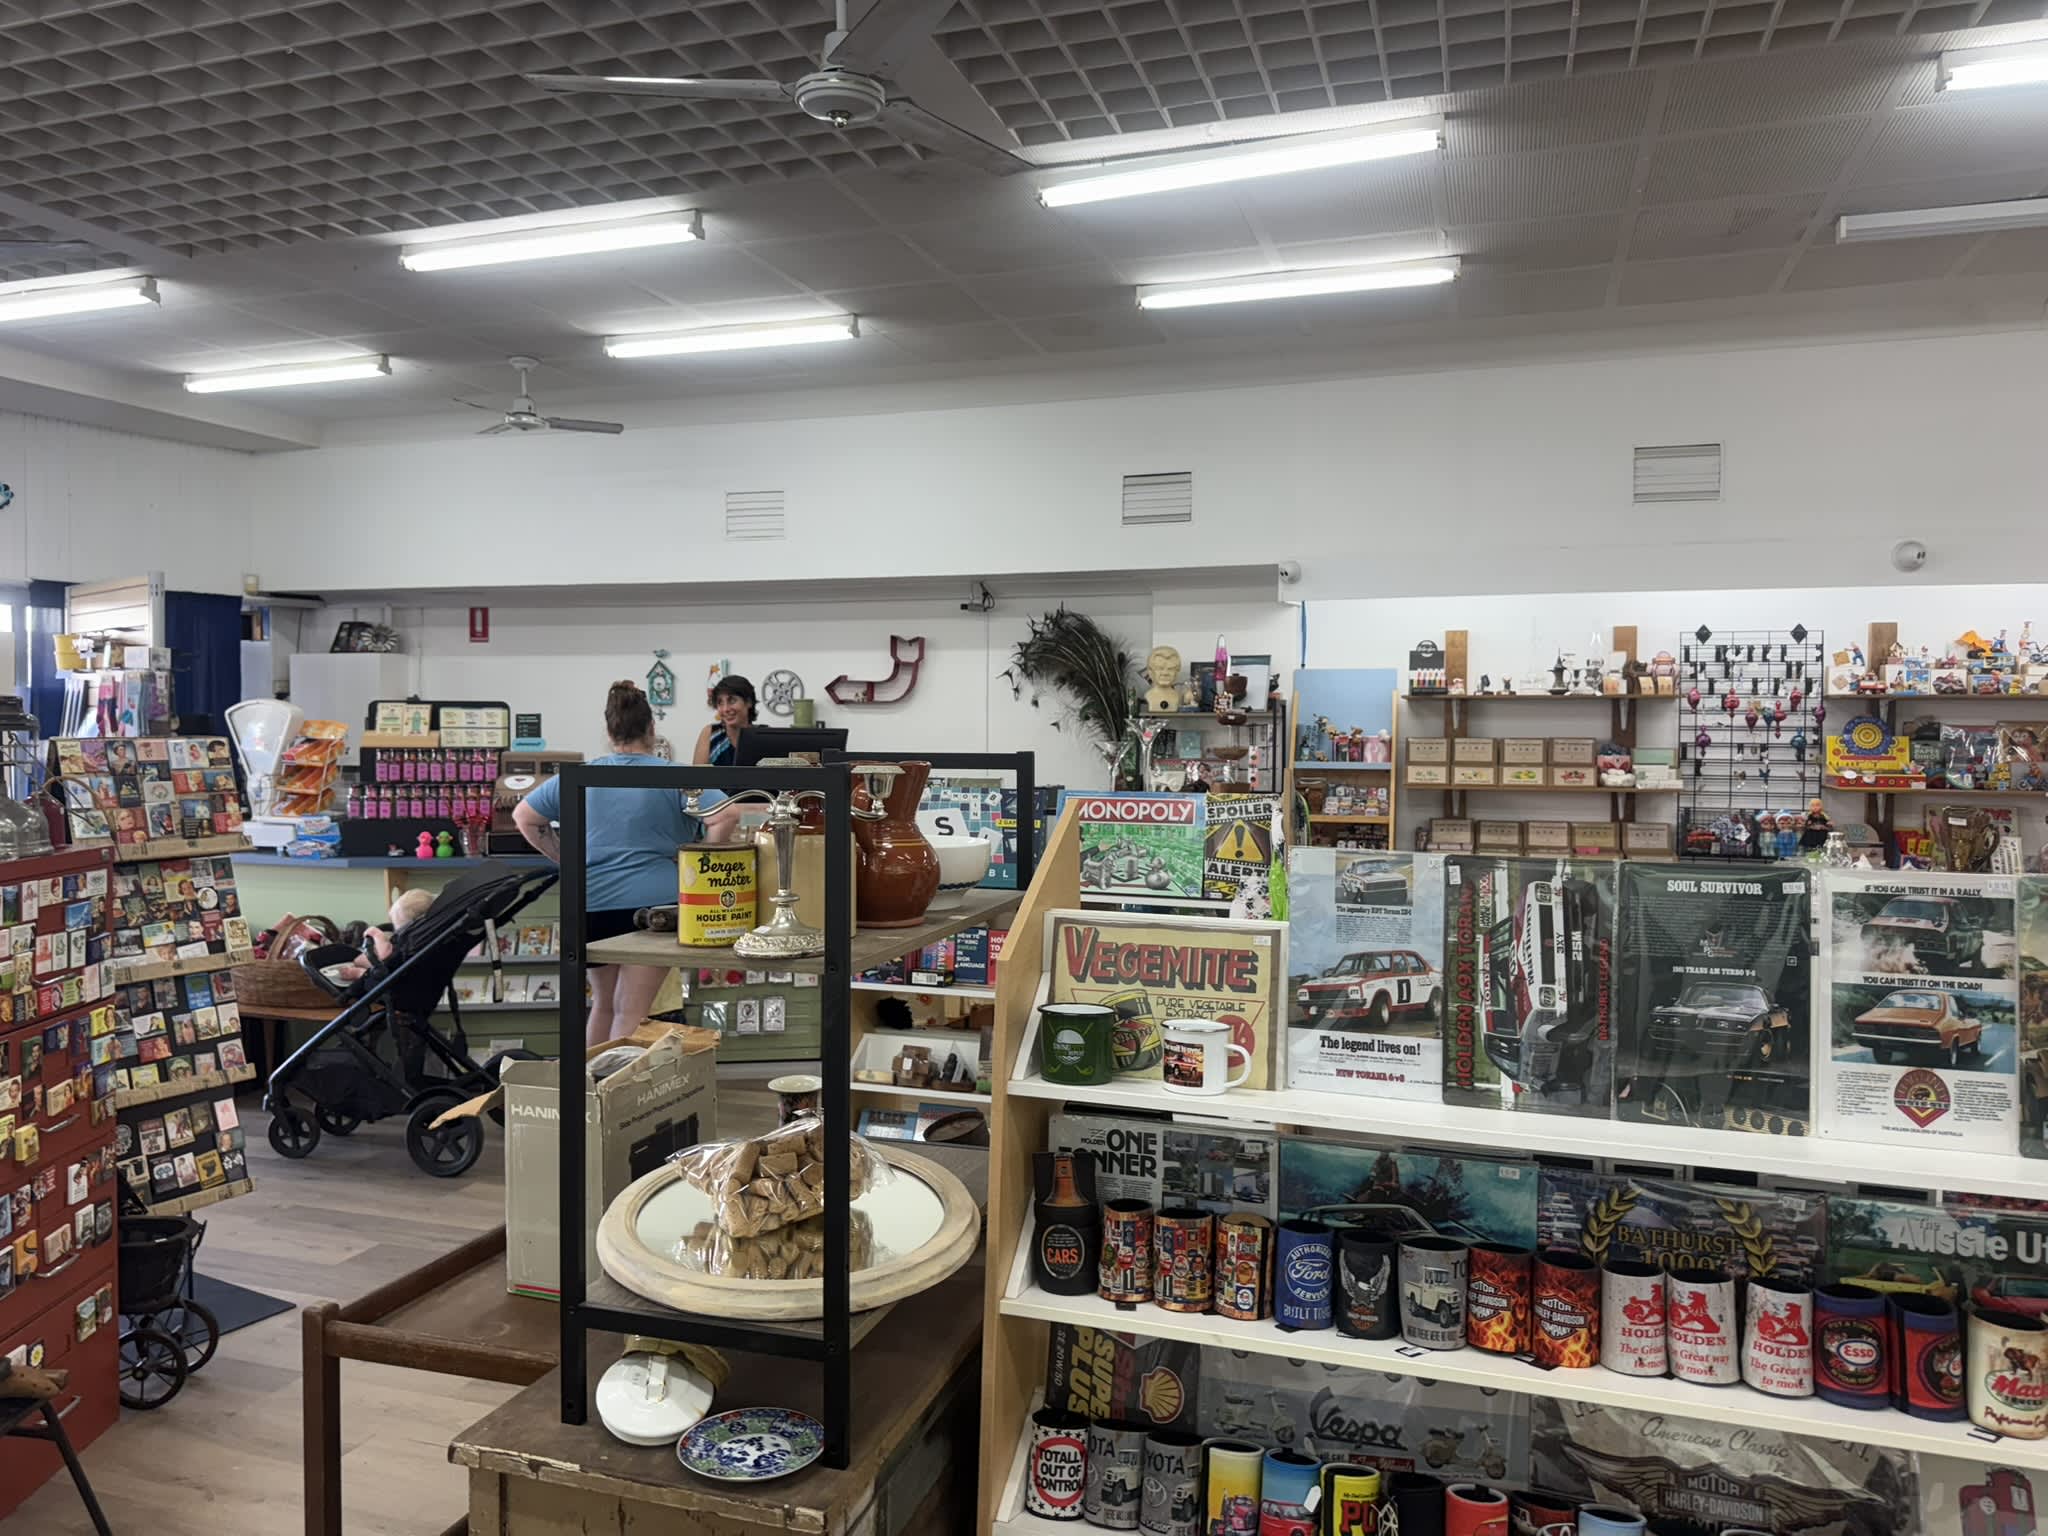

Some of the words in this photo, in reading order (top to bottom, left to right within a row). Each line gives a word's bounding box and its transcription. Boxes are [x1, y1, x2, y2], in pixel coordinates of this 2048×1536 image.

[1207, 803, 1273, 819] SPOILER
[698, 856, 746, 877] Berger
[707, 873, 753, 887] master
[1667, 880, 1698, 893] SOUL
[1700, 881, 1763, 895] SURVIVOR
[1873, 885, 1889, 893] YOU
[1890, 886, 1906, 894] CAN
[1908, 887, 1929, 895] TRUST
[1940, 888, 1948, 896] IN
[1949, 888, 1955, 896] A
[696, 914, 727, 922] HOUSE
[731, 911, 752, 921] PAINT
[1064, 926, 1259, 993] VEGEMITE
[1456, 960, 1475, 1001] A9X
[1863, 976, 1877, 984] YOU
[1879, 977, 1896, 985] CAN
[1897, 978, 1919, 986] TRUST
[1957, 982, 1984, 991] ROAD!
[1156, 997, 1185, 1009] PURE
[1189, 1000, 1246, 1013] VEGETABLE
[1165, 1008, 1217, 1021] EXTRACT
[1319, 1035, 1340, 1050] The
[1341, 1037, 1375, 1053] legend
[1377, 1039, 1402, 1055] lives
[1403, 1043, 1421, 1056] on!
[1456, 1005, 1475, 1087] HOLDEN
[1335, 1068, 1354, 1078] NEW
[1355, 1069, 1387, 1082] TORANA
[637, 1073, 691, 1106] HANIMEX
[1106, 1128, 1157, 1156] ONE
[1617, 1224, 1741, 1254] BATHURST
[1890, 1217, 2009, 1262] Aussie
[1047, 1247, 1079, 1265] CARS
[1291, 1259, 1329, 1280] Ford
[1283, 1303, 1311, 1320] BUILT
[1619, 1342, 1639, 1354] The
[1680, 1351, 1709, 1364] Great
[1843, 1344, 1874, 1359] Esso
[1067, 1326, 1095, 1416] PLUS
[1750, 1357, 1768, 1370] The
[1769, 1362, 1801, 1376] Great
[1090, 1334, 1115, 1419] SUPE
[1308, 1386, 1408, 1451] Vespa
[1639, 1416, 1722, 1449] American
[1728, 1429, 1790, 1459] Classic
[1039, 1449, 1082, 1465] TOTALL
[1040, 1462, 1065, 1478] OUT
[1067, 1464, 1082, 1478] OF
[1687, 1472, 1741, 1497] MOTOR
[1664, 1490, 1764, 1521] HARLEY-DAVIDSON
